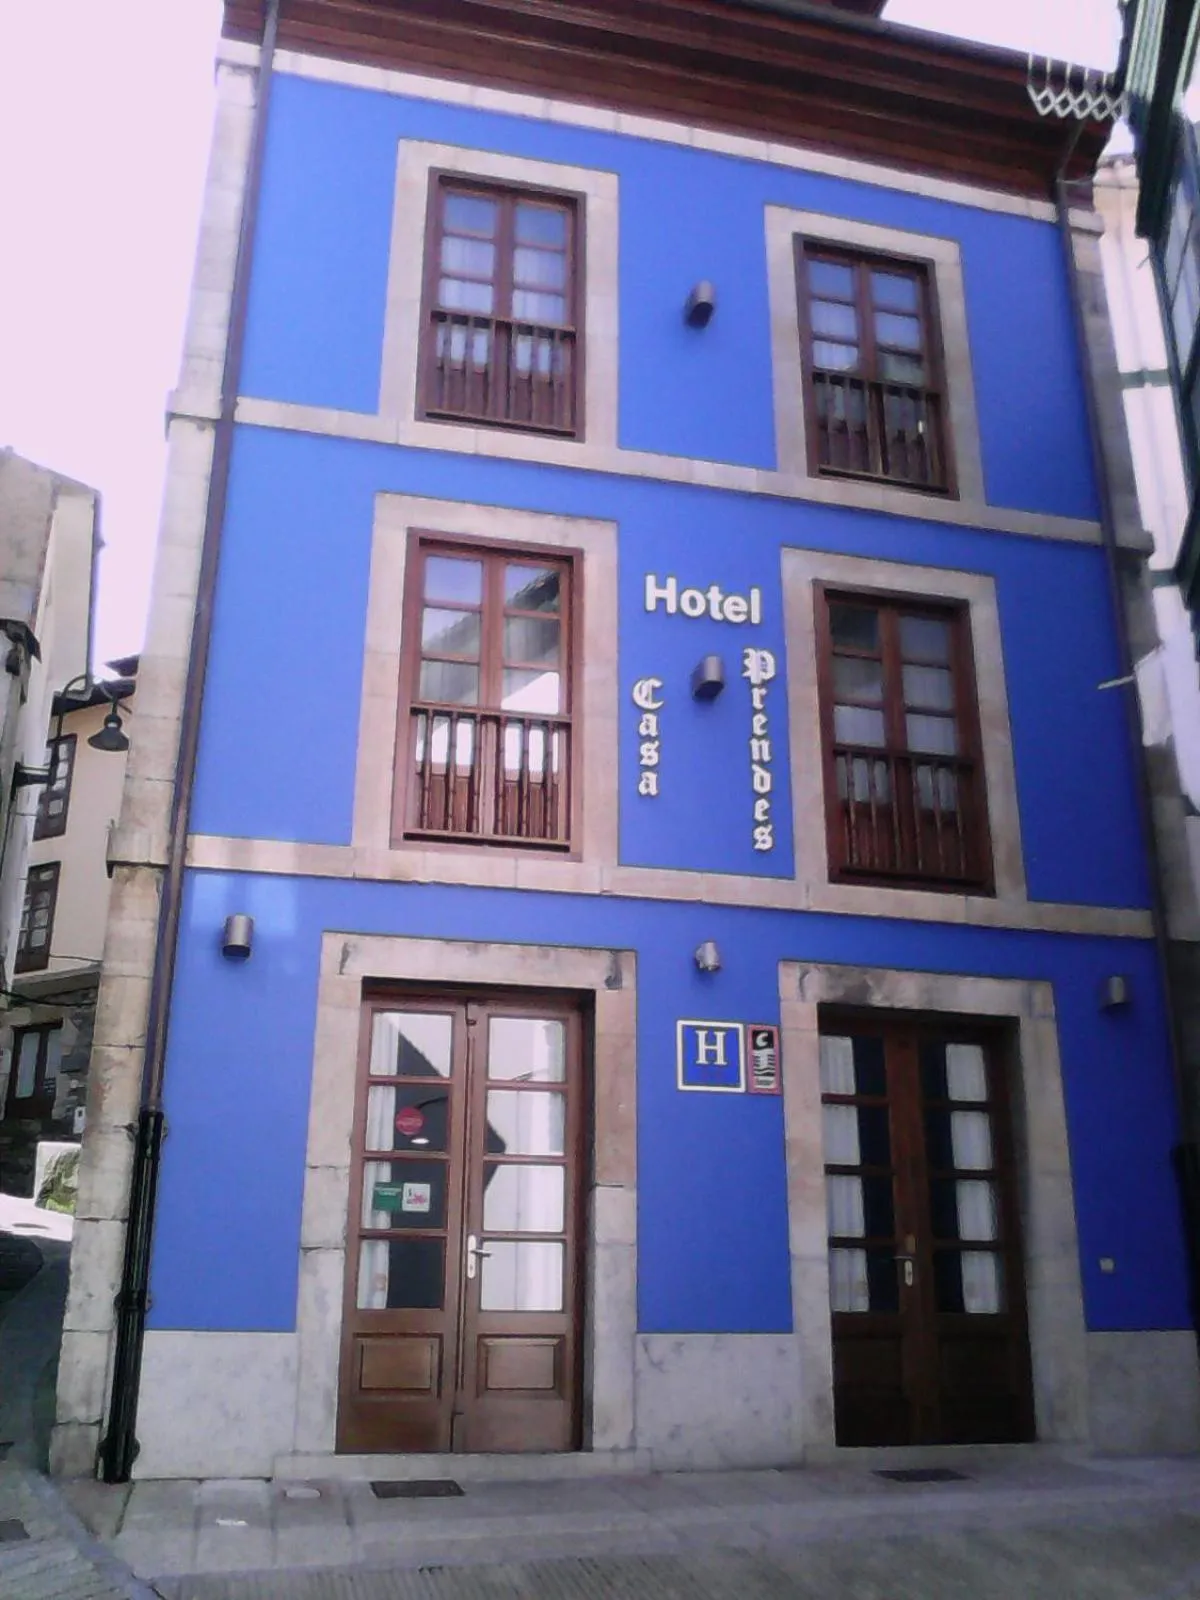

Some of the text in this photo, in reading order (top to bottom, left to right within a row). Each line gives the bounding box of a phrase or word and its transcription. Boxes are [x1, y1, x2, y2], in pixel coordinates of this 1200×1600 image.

[644, 574, 761, 624] Hotel
[632, 678, 664, 797] Casa
[741, 648, 777, 851] Prendes
[695, 1030, 727, 1066] H
